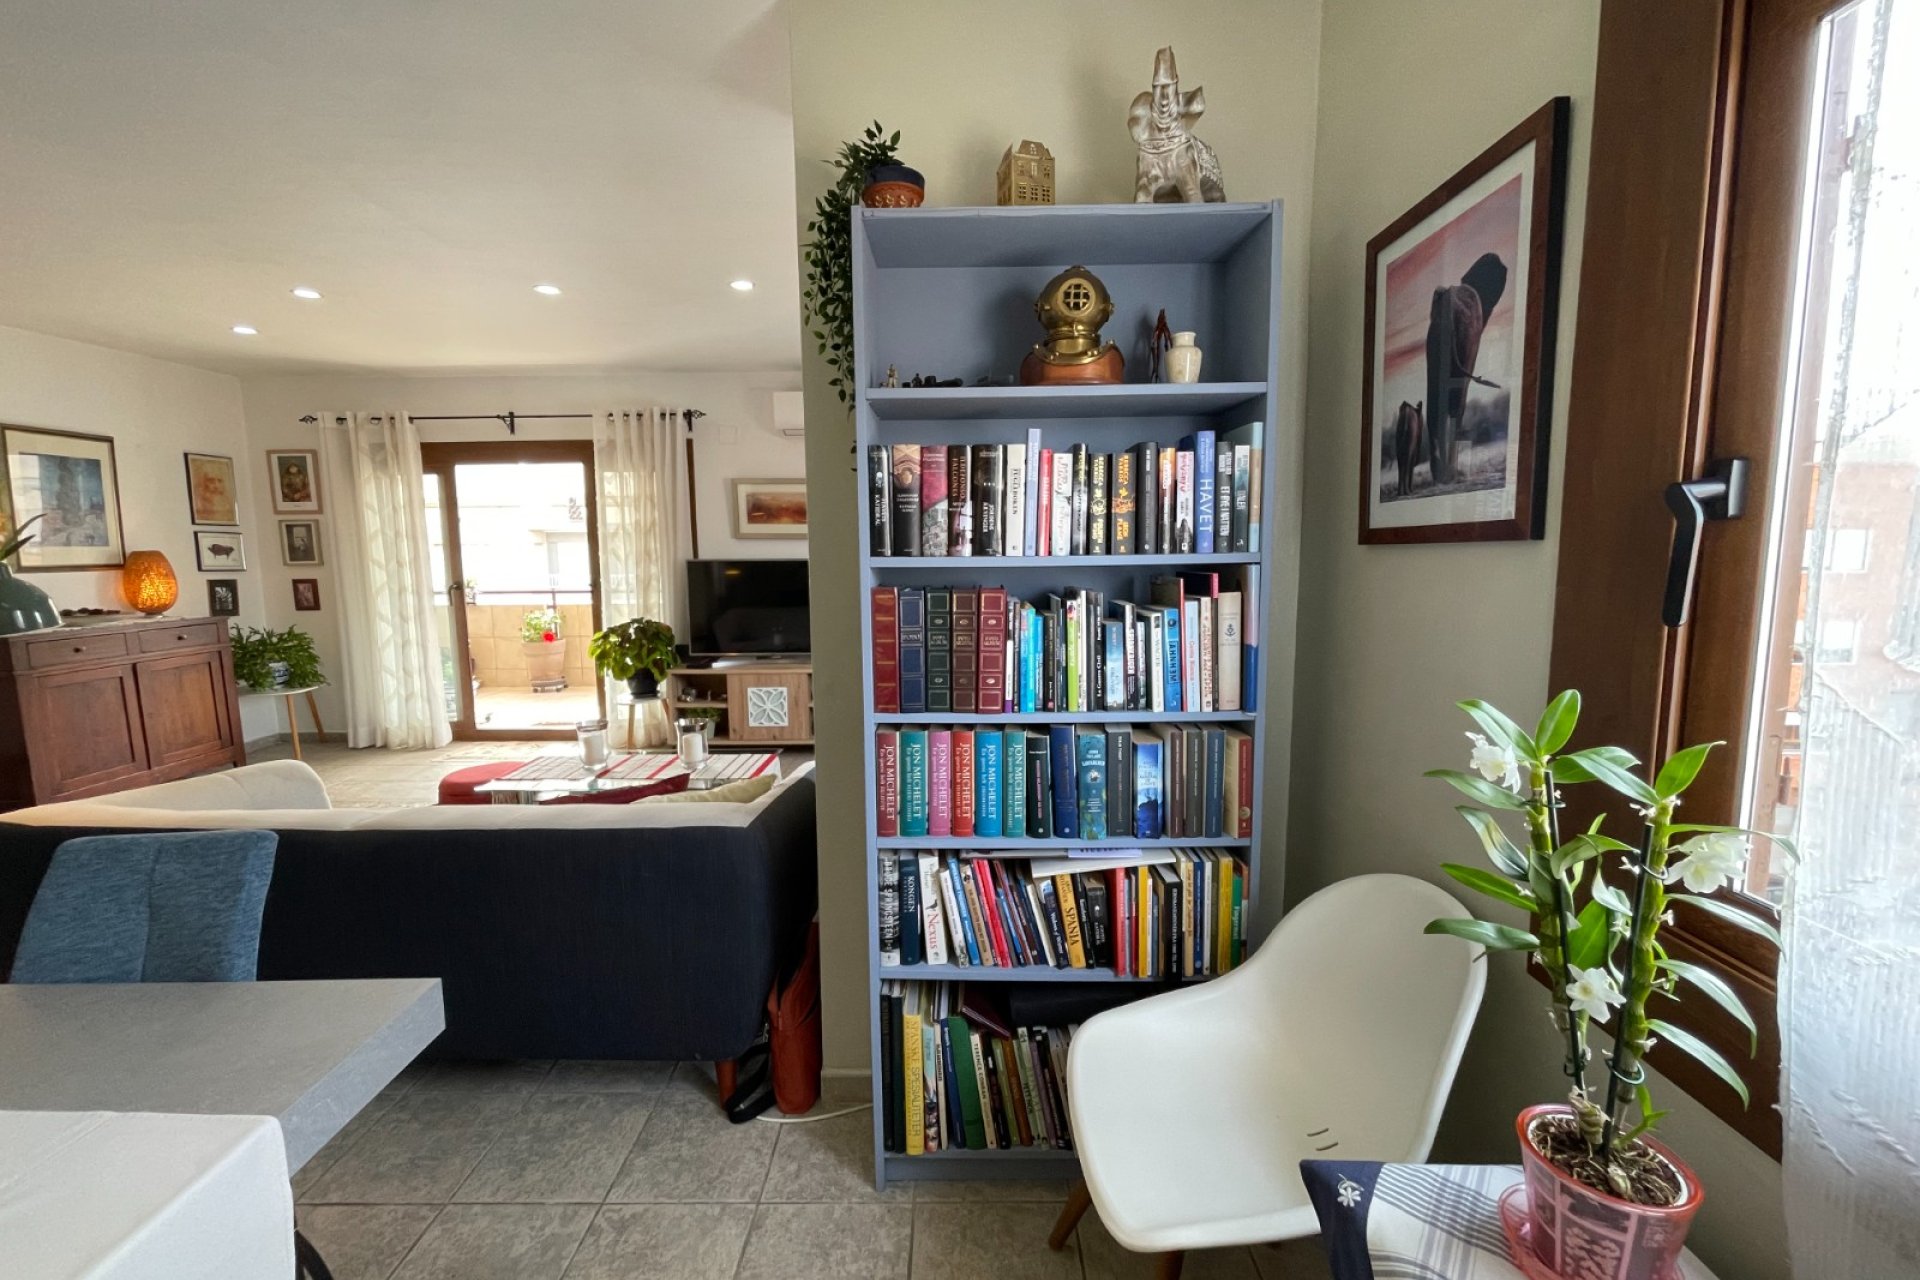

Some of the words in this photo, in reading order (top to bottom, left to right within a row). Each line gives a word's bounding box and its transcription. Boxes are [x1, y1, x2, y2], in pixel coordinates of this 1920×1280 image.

[959, 456, 967, 499] ILDEFONSO
[1199, 479, 1213, 533] HAVET
[884, 744, 895, 766] JON
[911, 743, 921, 764] JON
[936, 743, 947, 764] JON
[960, 742, 971, 764] JON
[985, 743, 996, 765] JON
[1012, 743, 1023, 764] JON
[886, 768, 895, 821] MICHELET
[912, 766, 921, 819] MICHELET
[938, 766, 947, 818] MICHELET
[962, 766, 971, 819] MICHELET
[988, 767, 997, 820] MICHELET
[1014, 766, 1023, 820] MICHELET
[884, 861, 894, 887] BRUCE
[908, 876, 916, 912] KONGEN
[884, 888, 894, 939] SPRINGSTEEN
[927, 913, 940, 949] Nexus
[1065, 907, 1080, 946] SPANIA
[910, 1021, 920, 1063] SPANSKE
[973, 1043, 983, 1070] TERENCE
[978, 1072, 988, 1099] CONRAN
[911, 1066, 921, 1136] SPESIALITETER
